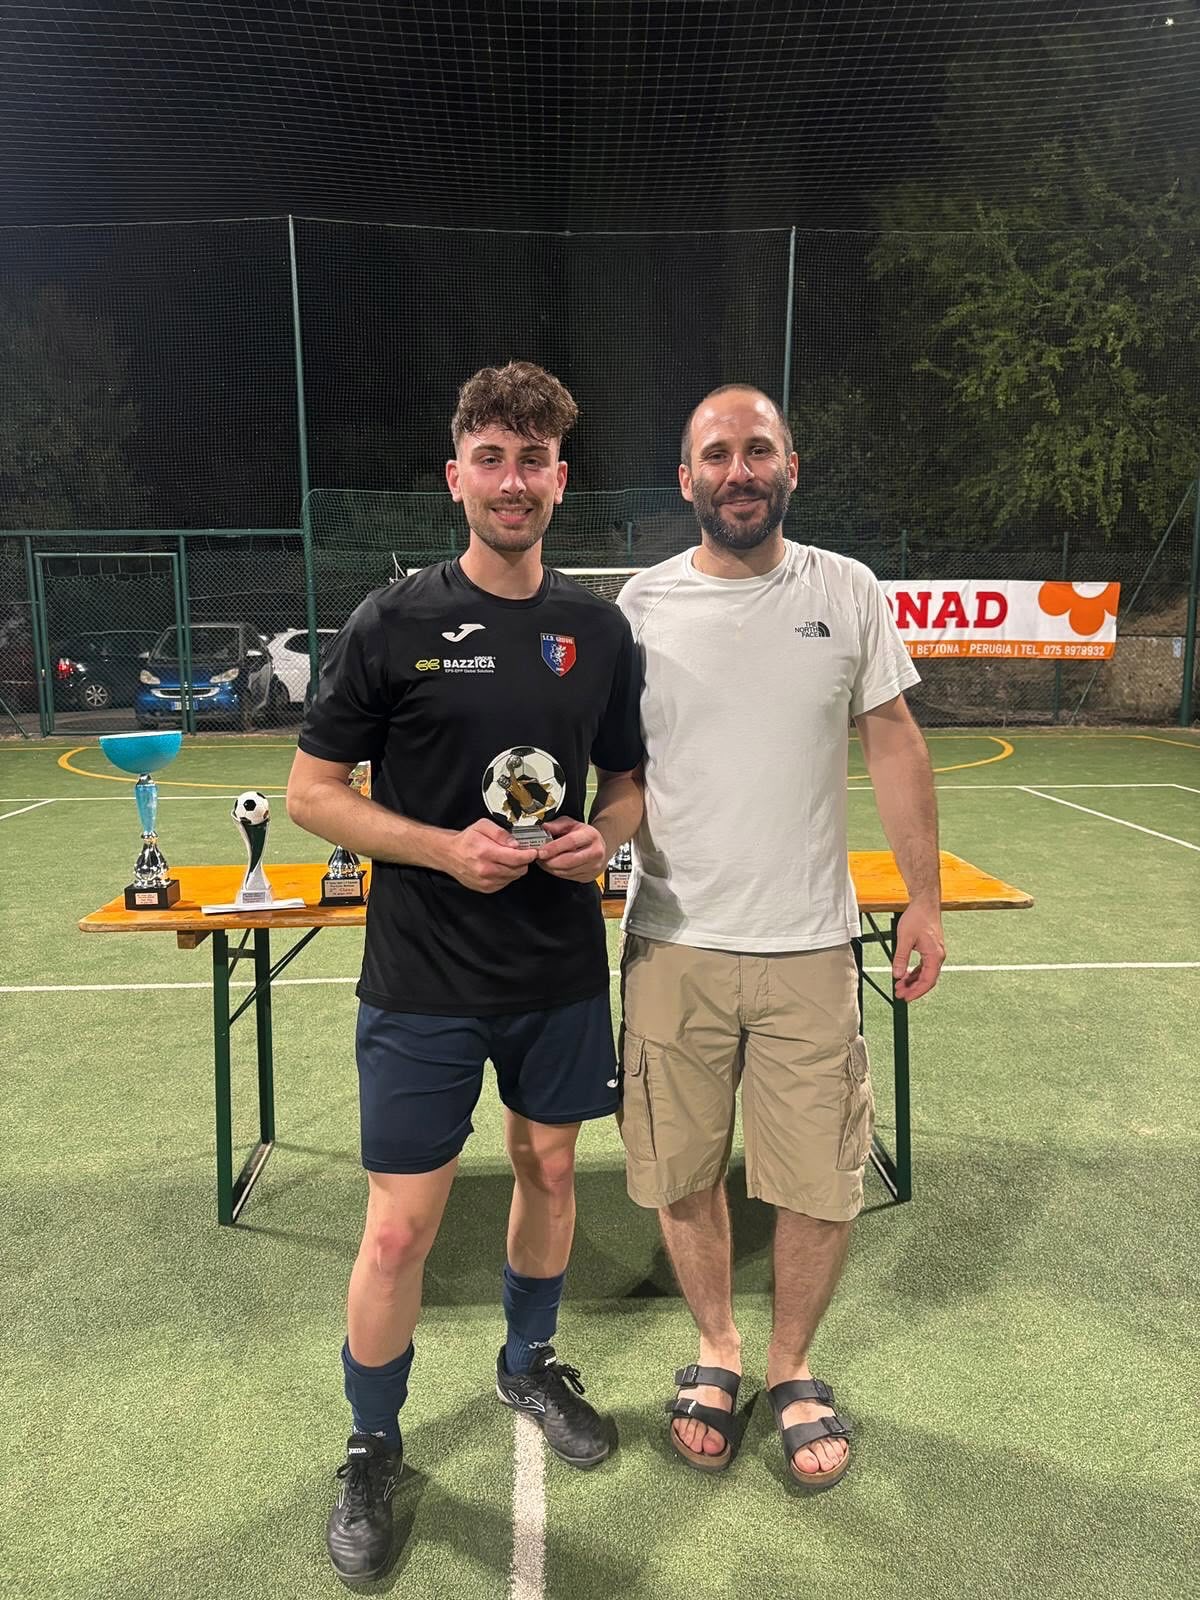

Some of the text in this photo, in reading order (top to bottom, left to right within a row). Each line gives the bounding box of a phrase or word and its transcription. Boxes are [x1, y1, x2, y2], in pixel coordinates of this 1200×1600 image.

[885, 591, 1008, 629] NAD
[917, 644, 960, 655] BETTONA
[969, 644, 1012, 655] PERUGIA
[1043, 645, 1062, 656] 075
[443, 659, 496, 669] BAZZICA
